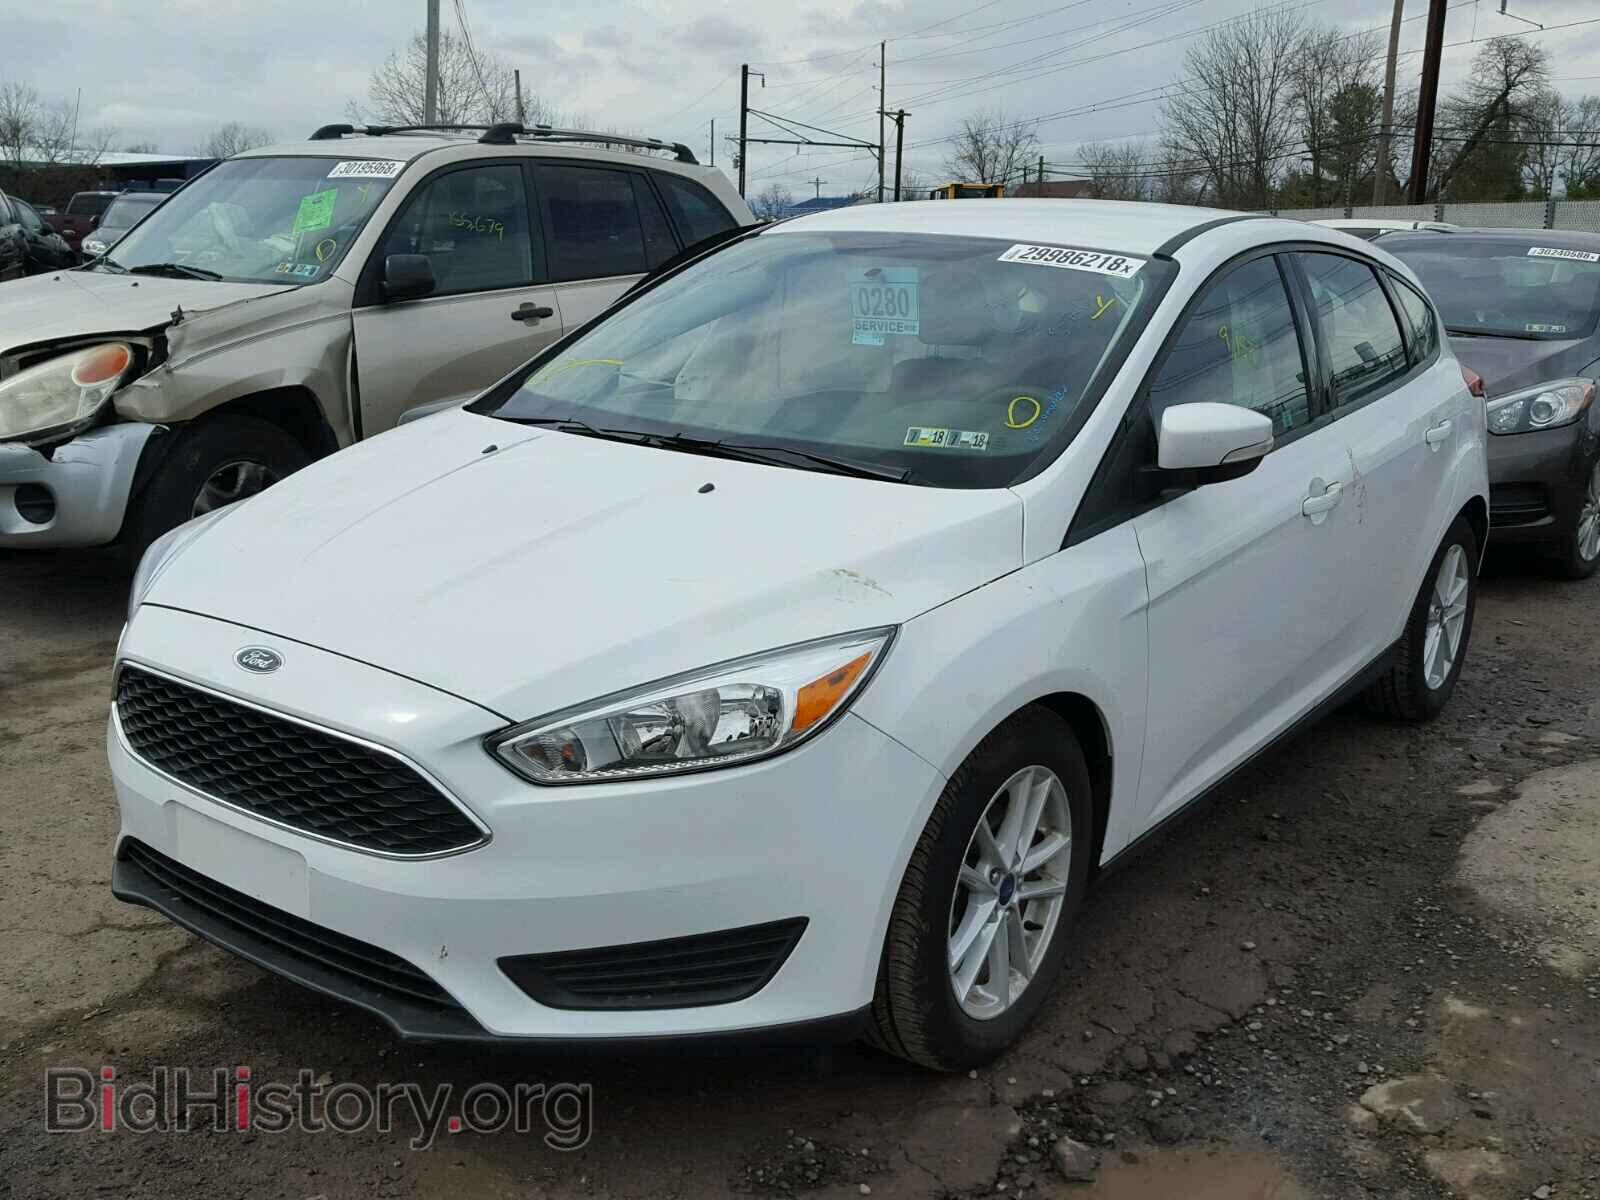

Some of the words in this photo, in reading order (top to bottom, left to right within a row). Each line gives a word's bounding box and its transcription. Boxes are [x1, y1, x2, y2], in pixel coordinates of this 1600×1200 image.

[859, 287, 909, 317] 0280
[855, 320, 905, 333] SERVICE
[242, 650, 274, 668] Ford
